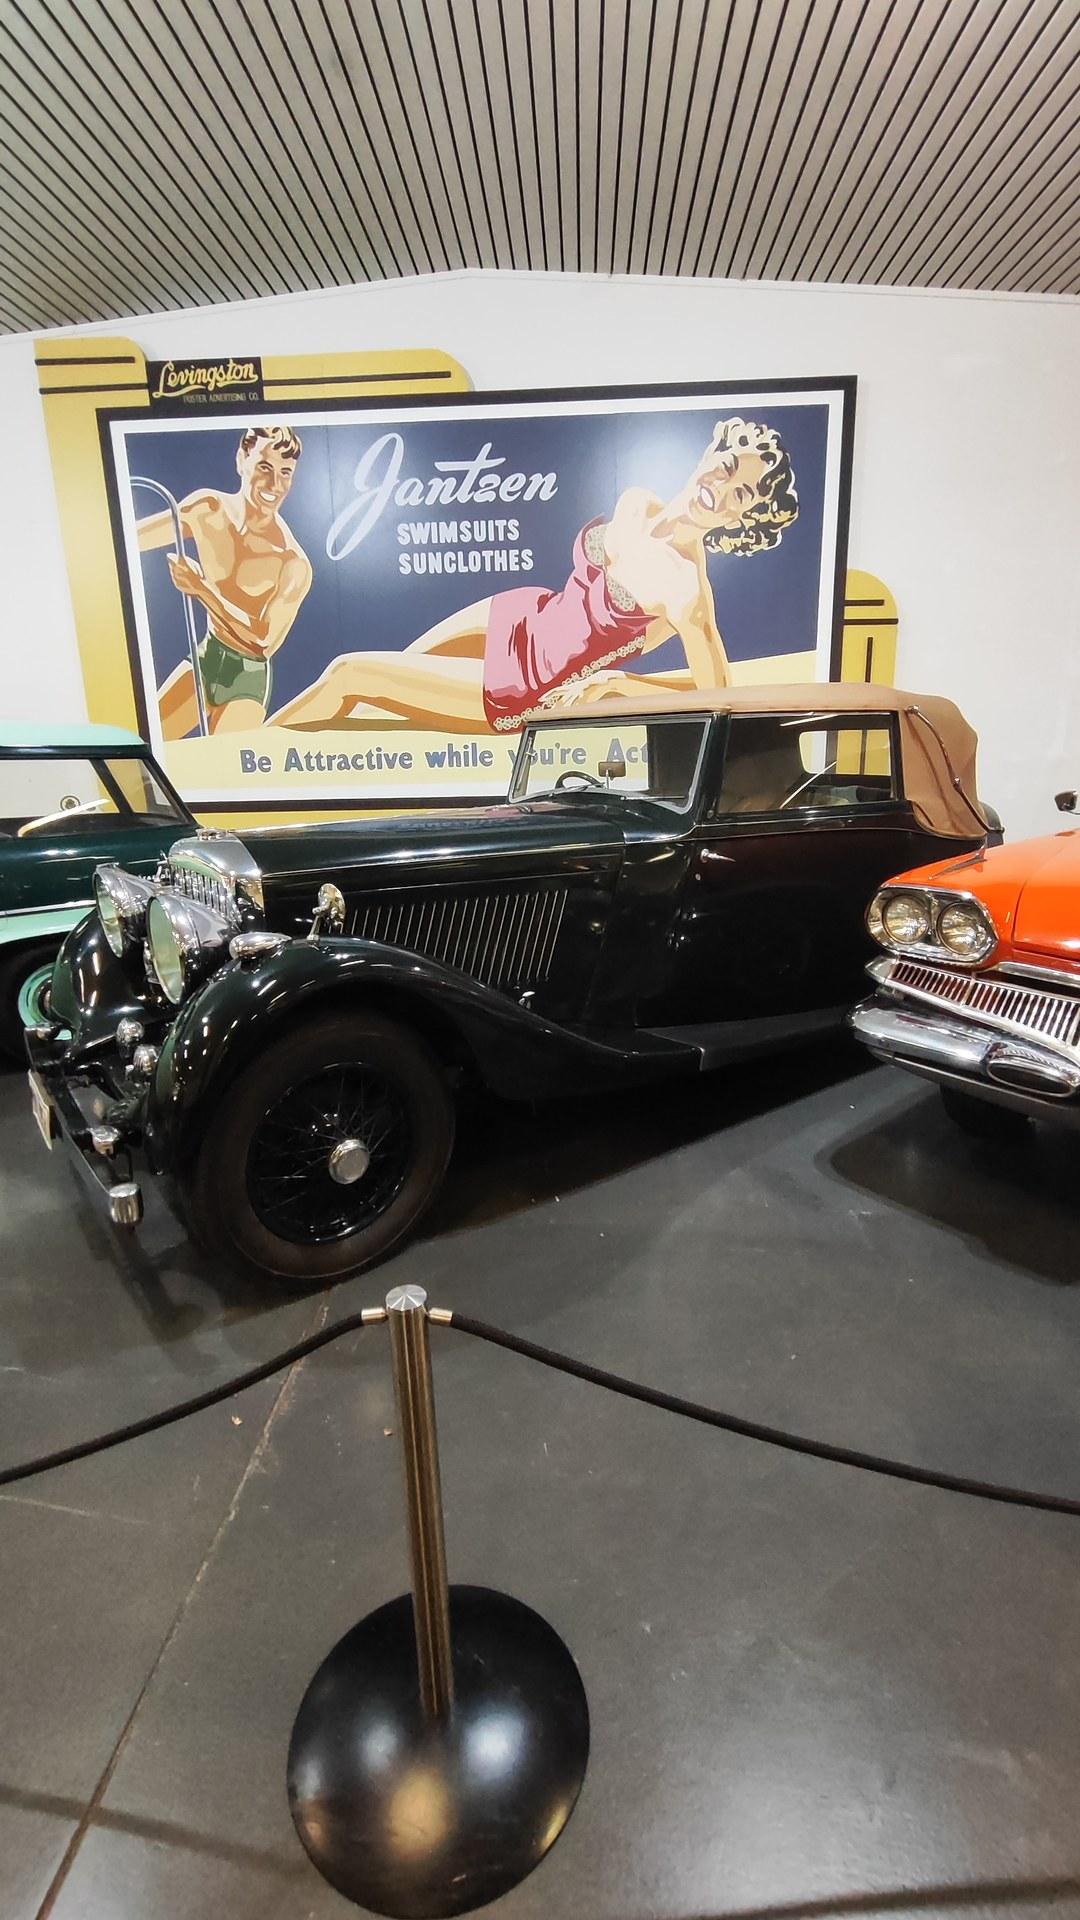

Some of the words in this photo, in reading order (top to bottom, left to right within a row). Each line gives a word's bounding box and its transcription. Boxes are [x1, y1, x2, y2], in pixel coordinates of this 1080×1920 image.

[152, 358, 259, 398] Levingston
[209, 392, 246, 402] ADVERTISING
[248, 392, 259, 401] CO.
[326, 432, 558, 561] Jantzen
[397, 519, 520, 545] SWIMSUITS
[399, 549, 534, 575] SUNCLOTHES
[240, 750, 272, 773] Be
[284, 747, 413, 772] Attractive
[425, 743, 494, 769] while
